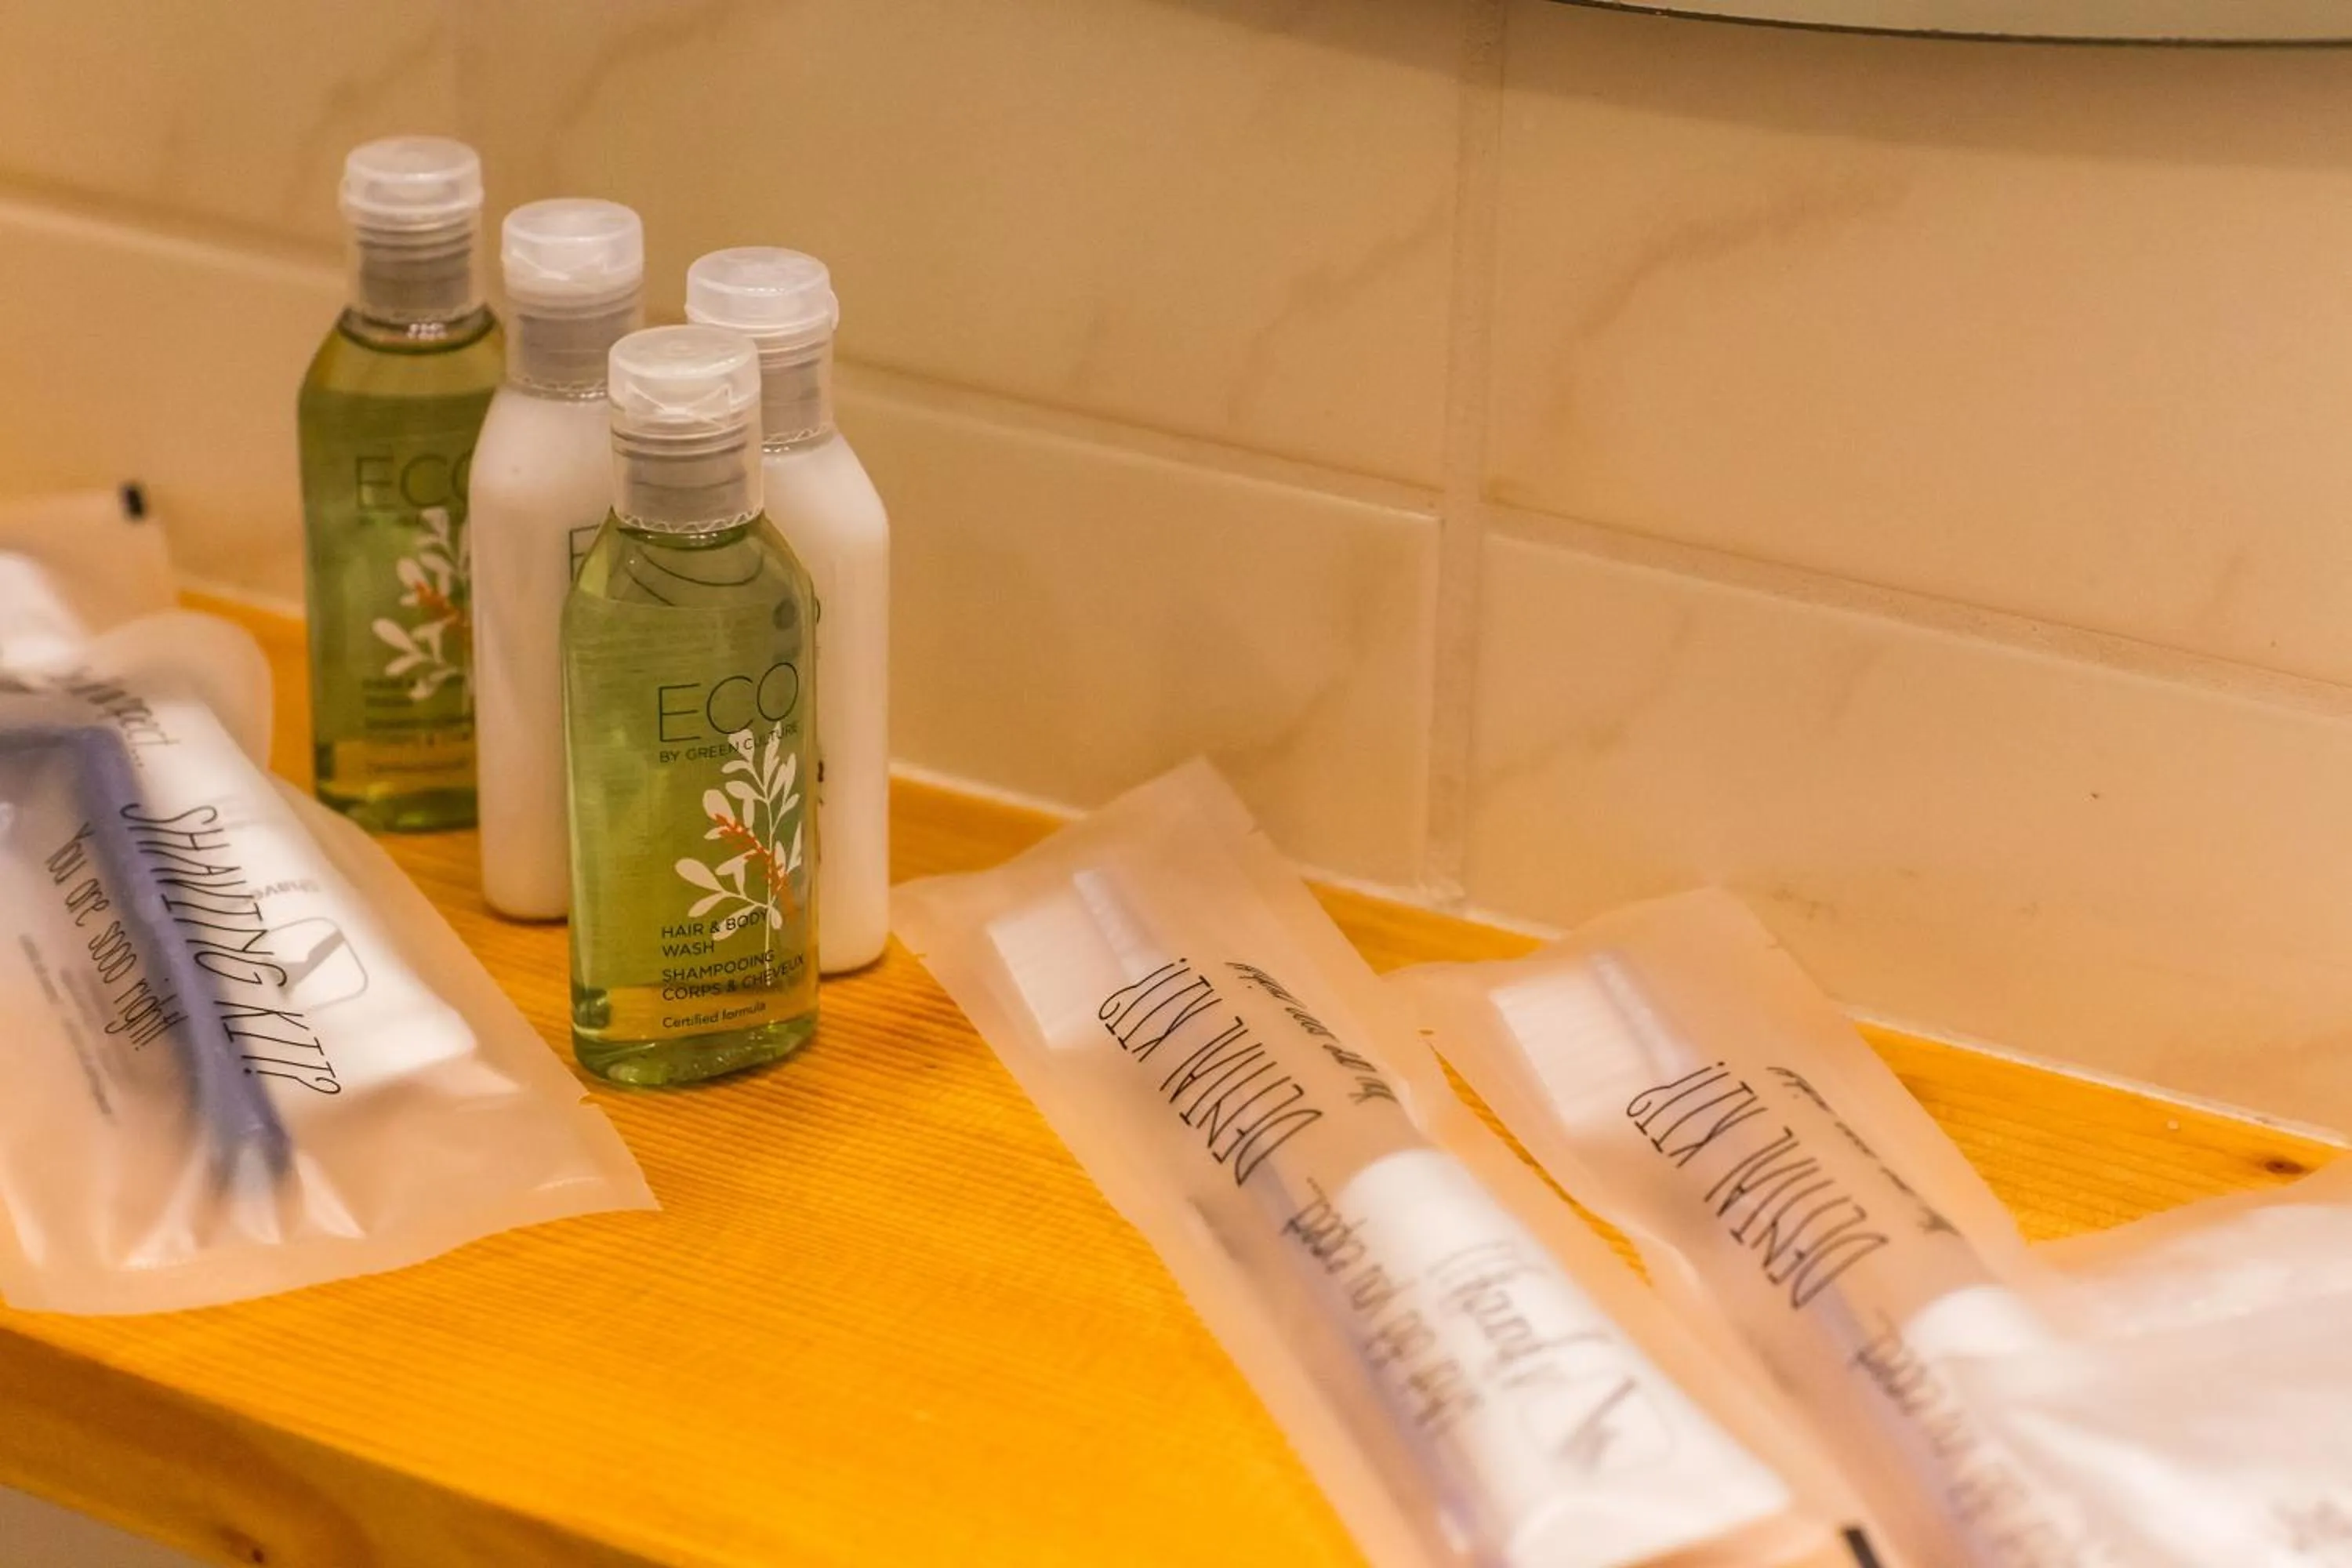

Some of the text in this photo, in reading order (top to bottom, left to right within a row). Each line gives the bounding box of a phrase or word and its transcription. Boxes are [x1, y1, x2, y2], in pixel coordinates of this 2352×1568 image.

[659, 662, 799, 742] ECO
[659, 749, 681, 764] BY
[686, 741, 739, 761] GREEN
[45, 821, 96, 886] You
[64, 877, 111, 927] are
[662, 909, 768, 939] HAIR & BODY
[88, 920, 138, 985] sooo
[119, 802, 288, 988] SHAVING
[212, 1000, 342, 1094] KIT?
[662, 941, 715, 958] WASH
[662, 949, 775, 982] SHAMPOOING
[662, 953, 804, 1002] CORPS & CHEVEUX
[662, 1002, 766, 1029] Certified formula
[1098, 957, 1323, 1187] DENTAL KIT?
[1626, 1061, 1768, 1169] KIT?
[1704, 1125, 1890, 1311] DENTAL
